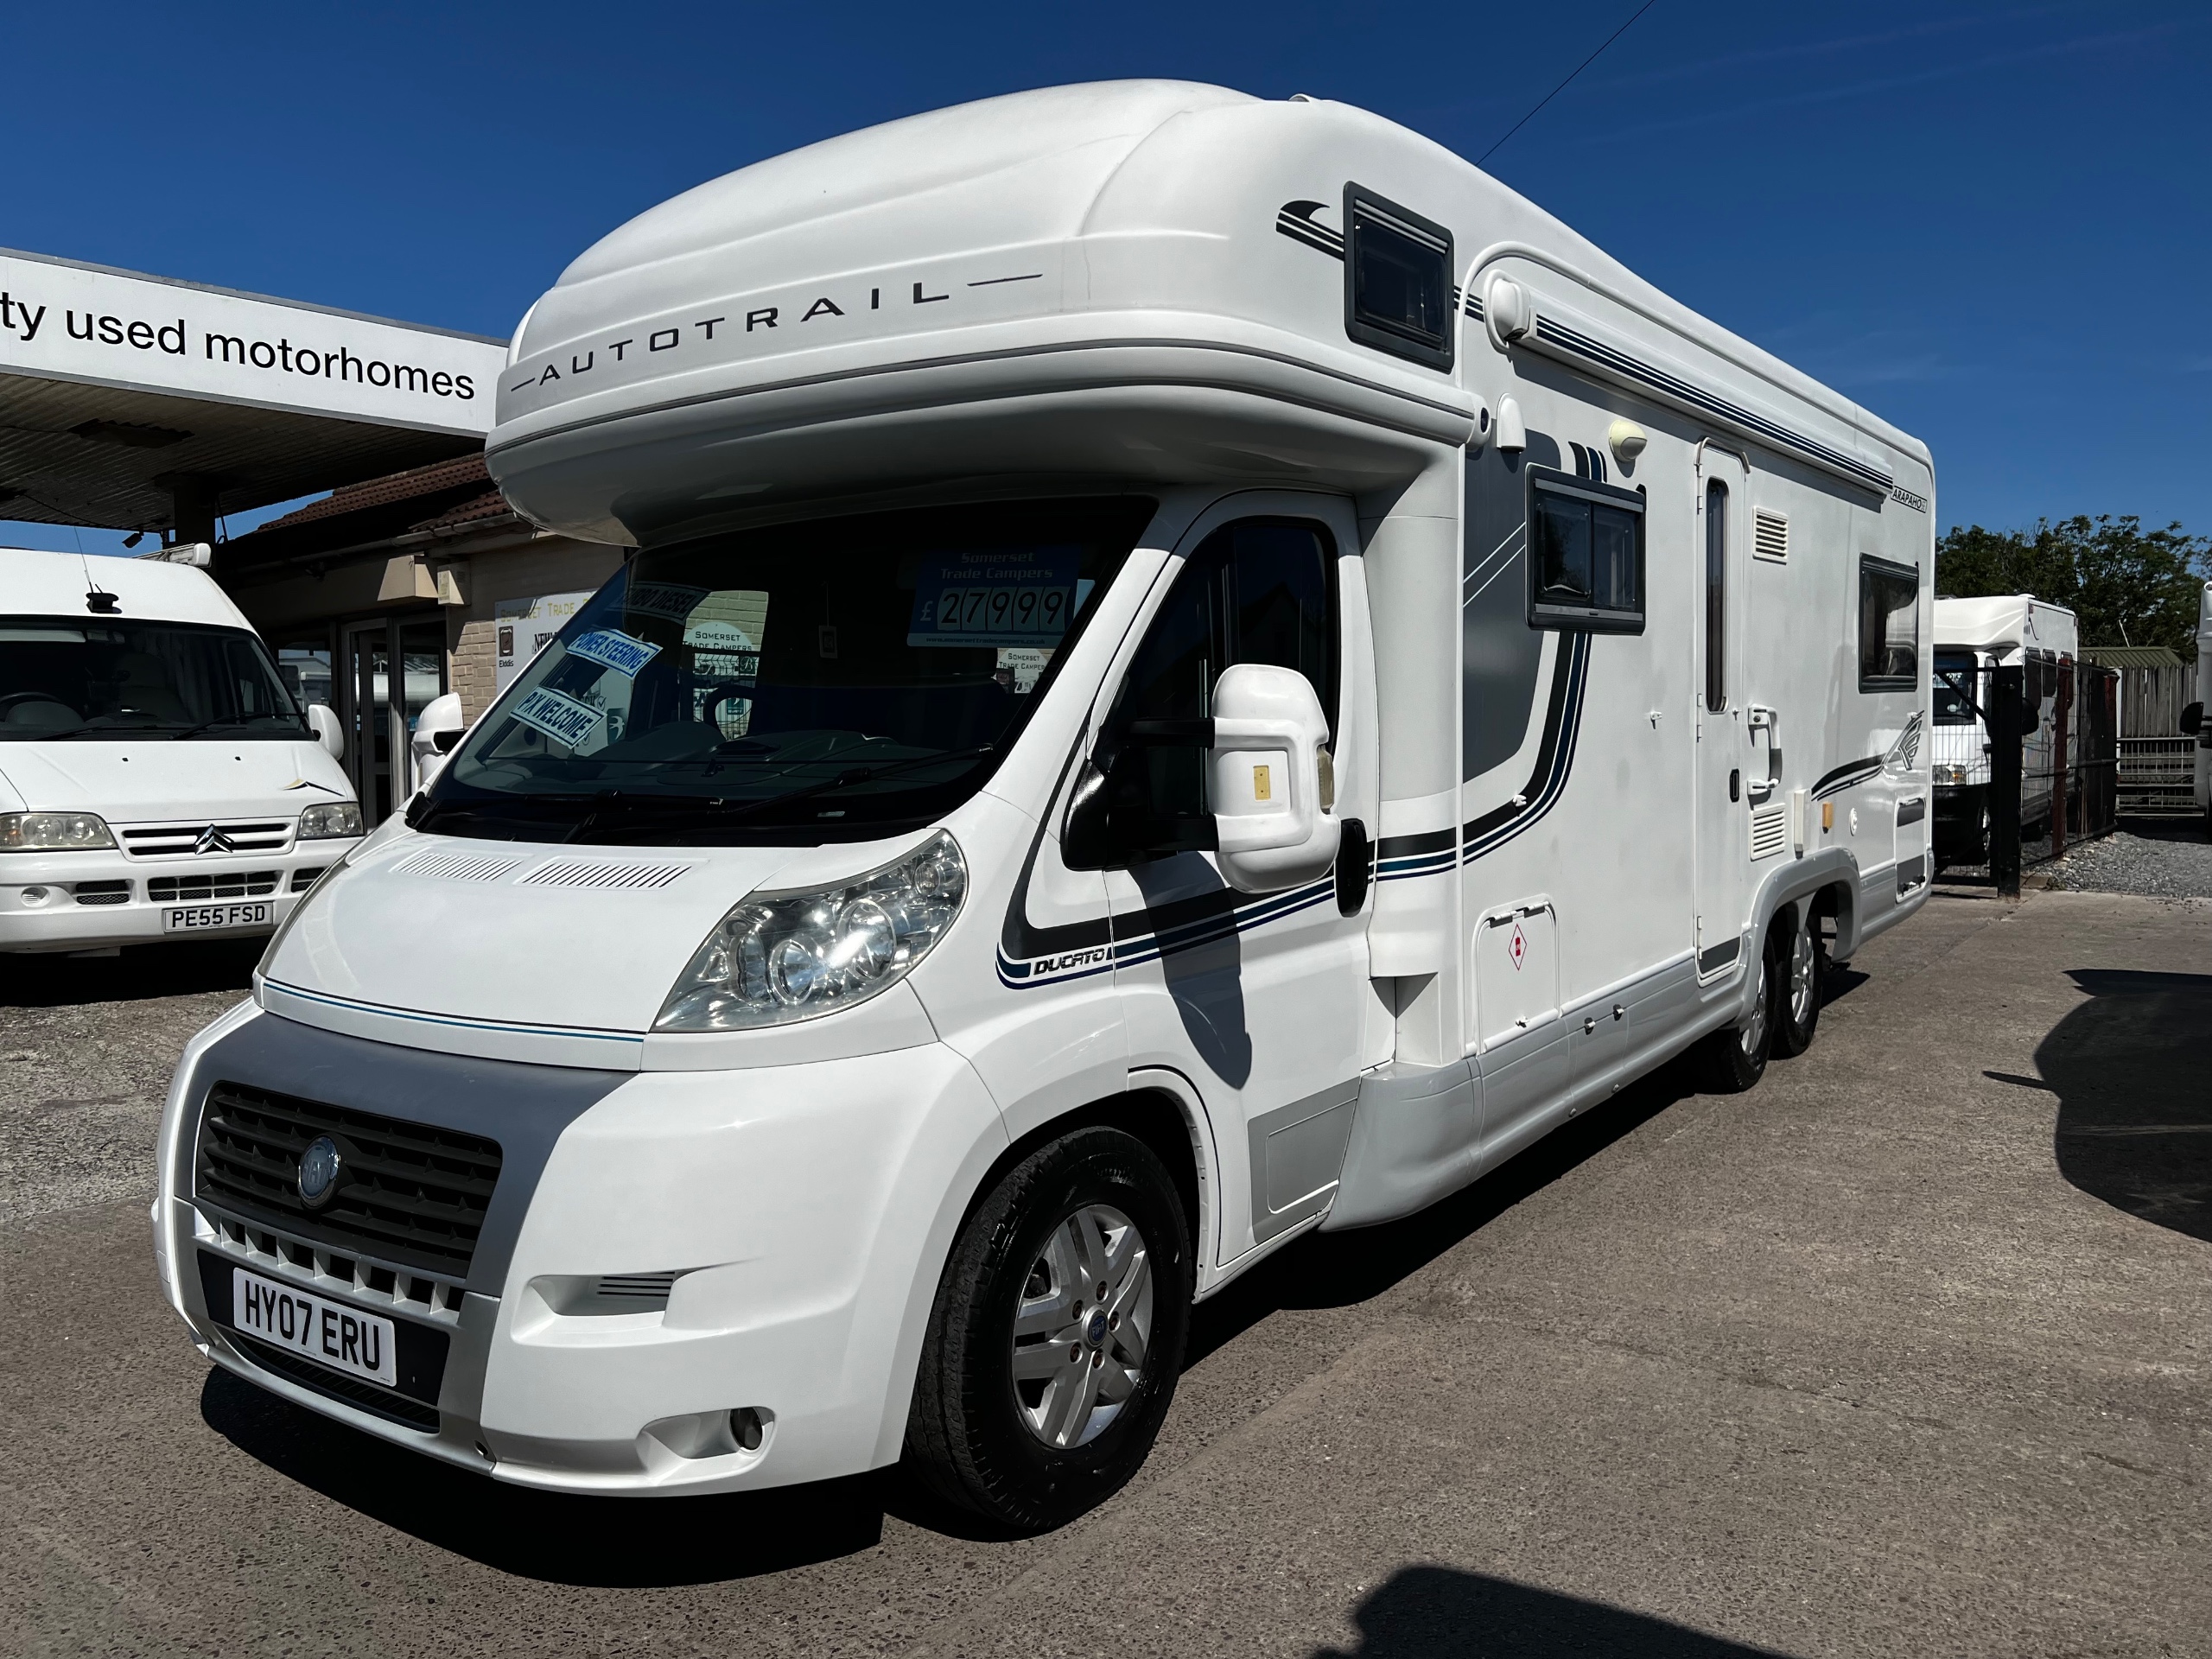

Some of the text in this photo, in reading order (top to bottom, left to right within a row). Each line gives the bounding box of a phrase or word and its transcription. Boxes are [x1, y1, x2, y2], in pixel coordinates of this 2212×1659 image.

[538, 281, 950, 385] AUTOTRAIL
[66, 309, 186, 355] used
[206, 331, 474, 400] motorhomes
[1892, 488, 1922, 508] ARAPAHO
[961, 552, 1036, 563] Somerset
[941, 568, 1054, 582] Trade Campers
[547, 602, 575, 617] TRADE
[649, 590, 697, 613] DIESEL
[695, 631, 741, 641] SOMERSET
[571, 632, 650, 670] POWER STEERING
[683, 641, 753, 652] TRADE CAMPERS
[1007, 652, 1040, 661] SOMERSET
[999, 661, 1019, 670] TRADE
[532, 697, 594, 739] WELCOME
[172, 905, 265, 928] PE55 FSD
[1033, 948, 1105, 976] DUCATO
[245, 1279, 380, 1371] HY07 ERU
[1091, 1319, 1104, 1338] FIAT
